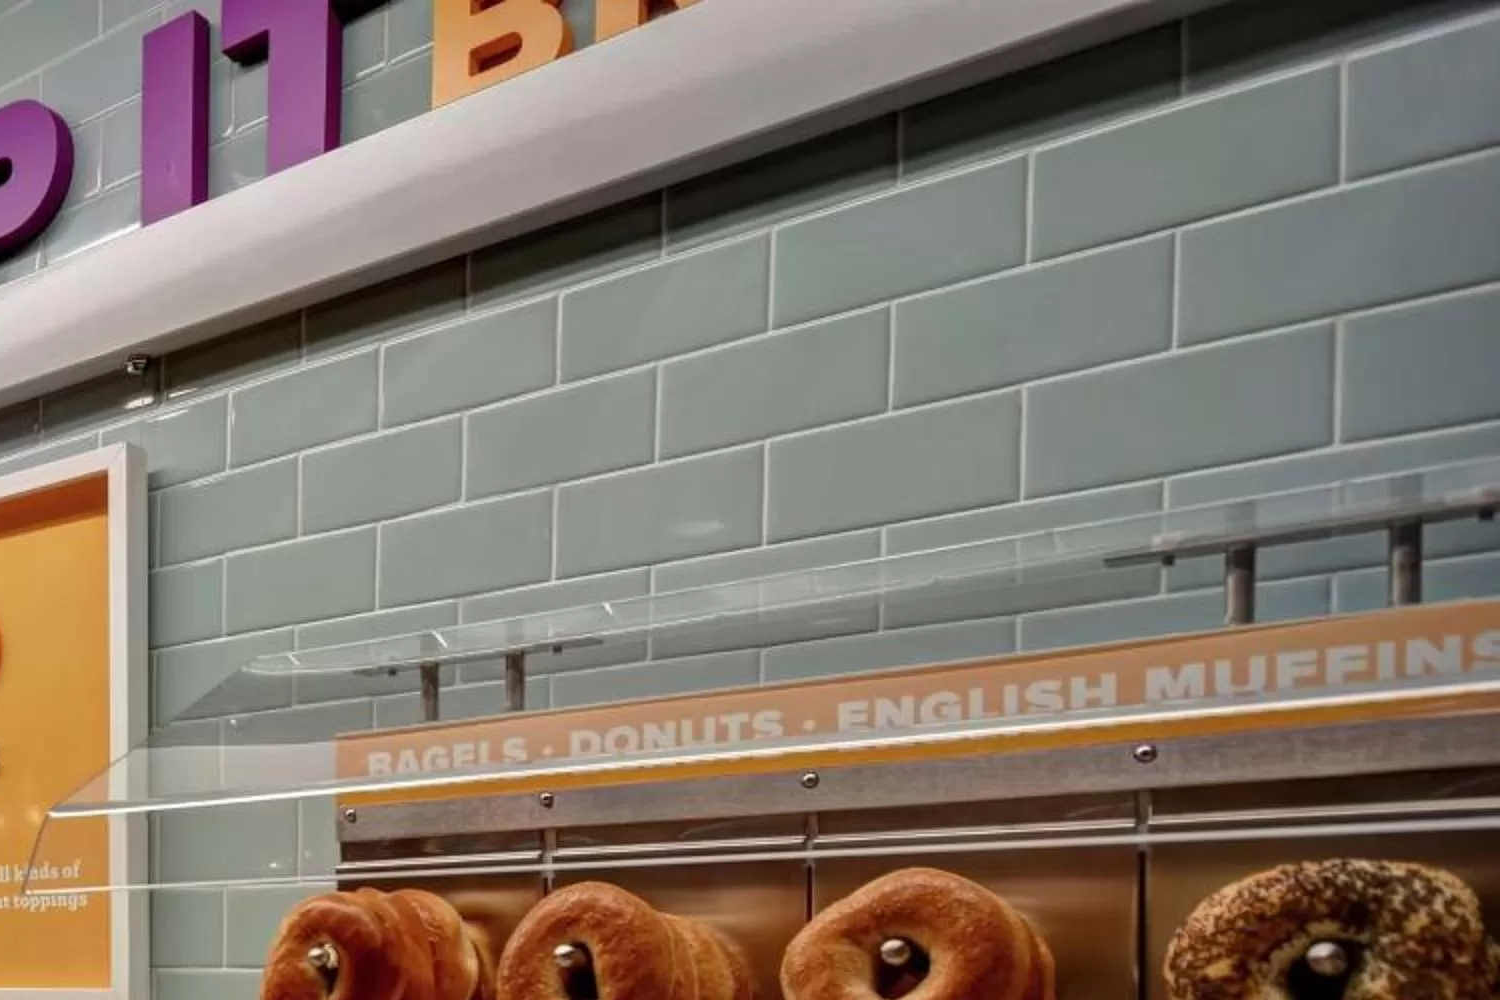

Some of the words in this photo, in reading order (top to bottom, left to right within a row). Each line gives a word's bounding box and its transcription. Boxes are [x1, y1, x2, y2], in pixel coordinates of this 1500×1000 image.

[142, 0, 342, 229] IT
[367, 737, 528, 777] BAGELS
[569, 709, 784, 757] DONUTS
[837, 674, 1117, 733] ENGLISH
[62, 860, 81, 879] of
[13, 892, 88, 912] toppings
